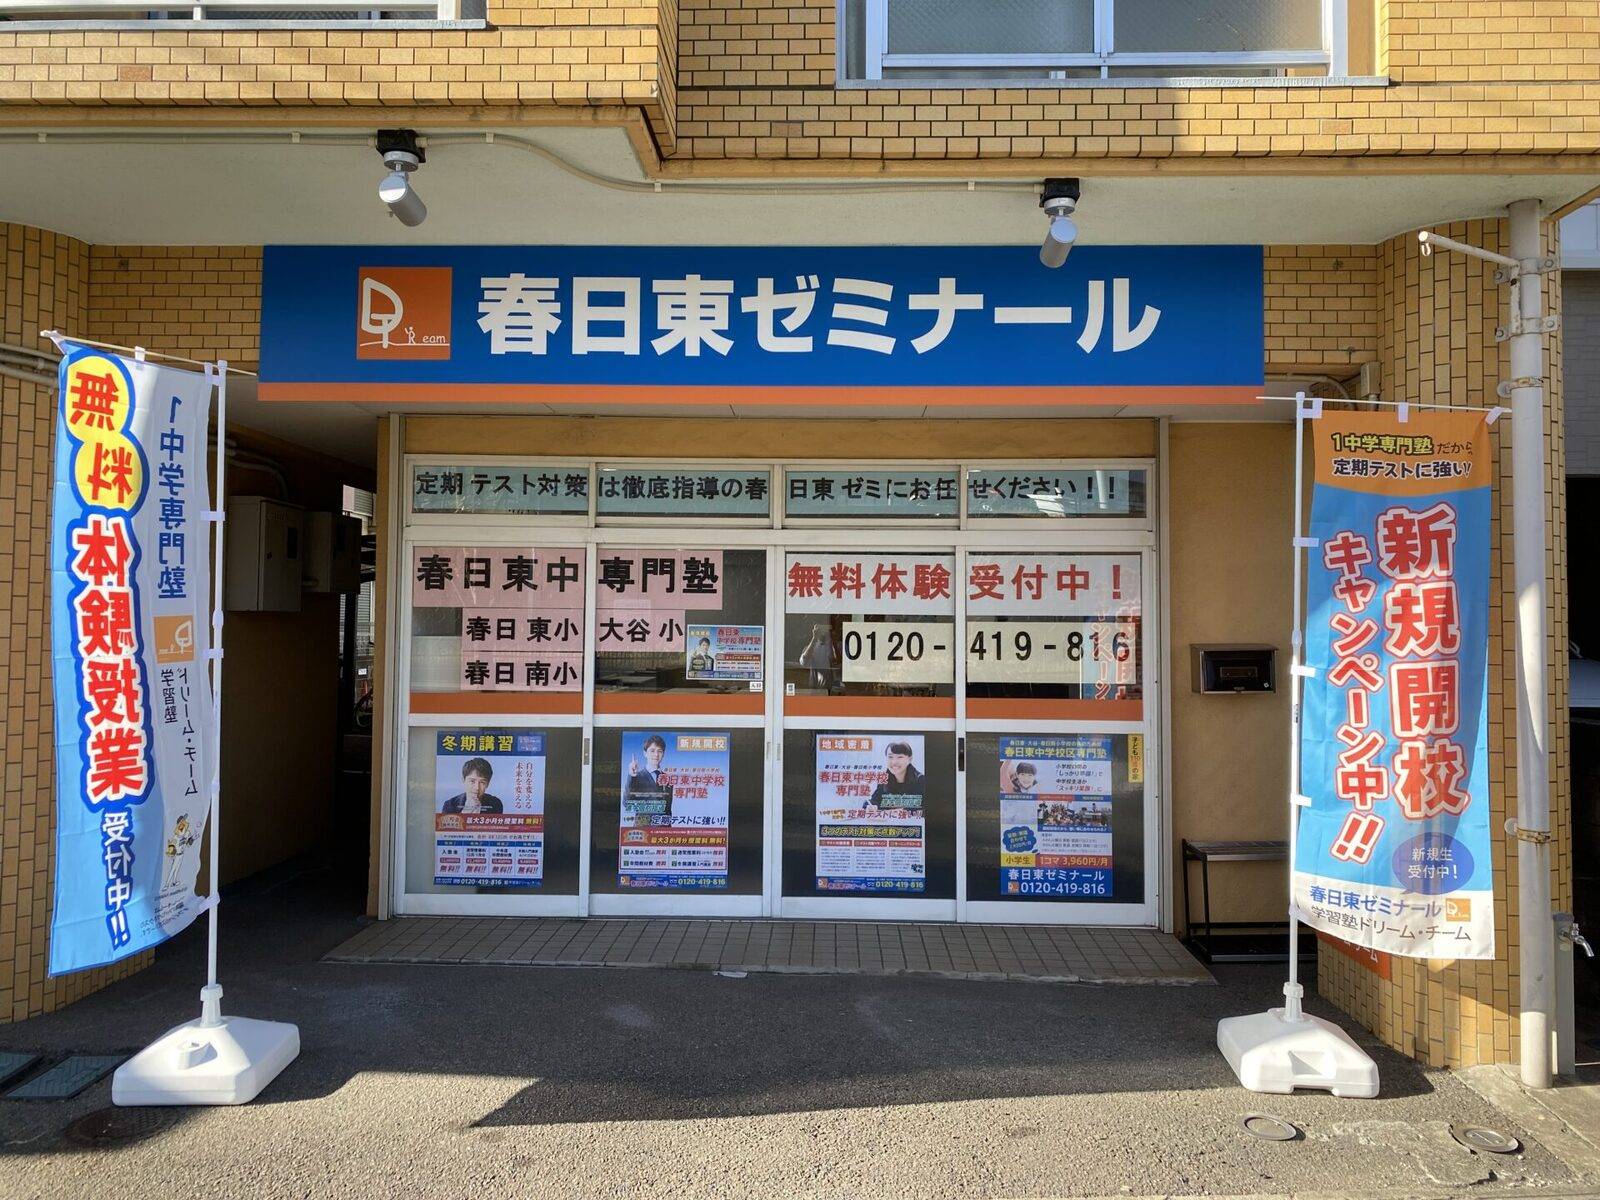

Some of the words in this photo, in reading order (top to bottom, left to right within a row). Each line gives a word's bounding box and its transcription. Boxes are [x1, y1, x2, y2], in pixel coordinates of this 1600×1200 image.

[477, 273, 1162, 356] 春日東ゼミナール
[466, 617, 579, 642] 春日東小
[599, 618, 684, 642] 大谷小
[1380, 505, 1468, 817] 新規開校
[465, 660, 578, 685] 春日南小
[1326, 534, 1388, 862] キャンペーン中!!
[442, 735, 514, 752] 冬期講習
[822, 739, 871, 750] 地域密着
[657, 774, 725, 787] 春日東中学校
[819, 771, 889, 784] 春日東中学校
[673, 788, 709, 799] 専門塾
[835, 785, 871, 796] 専門塾
[1005, 856, 1031, 865] 小学生
[1411, 847, 1454, 862] 新規生
[1008, 869, 1105, 881] 春日東ゼミナール
[1021, 882, 1105, 895] 0120-419-816
[1310, 885, 1442, 918] 春日東ゼミナール
[1311, 905, 1473, 942] 学習塾ドリーム・チーム
